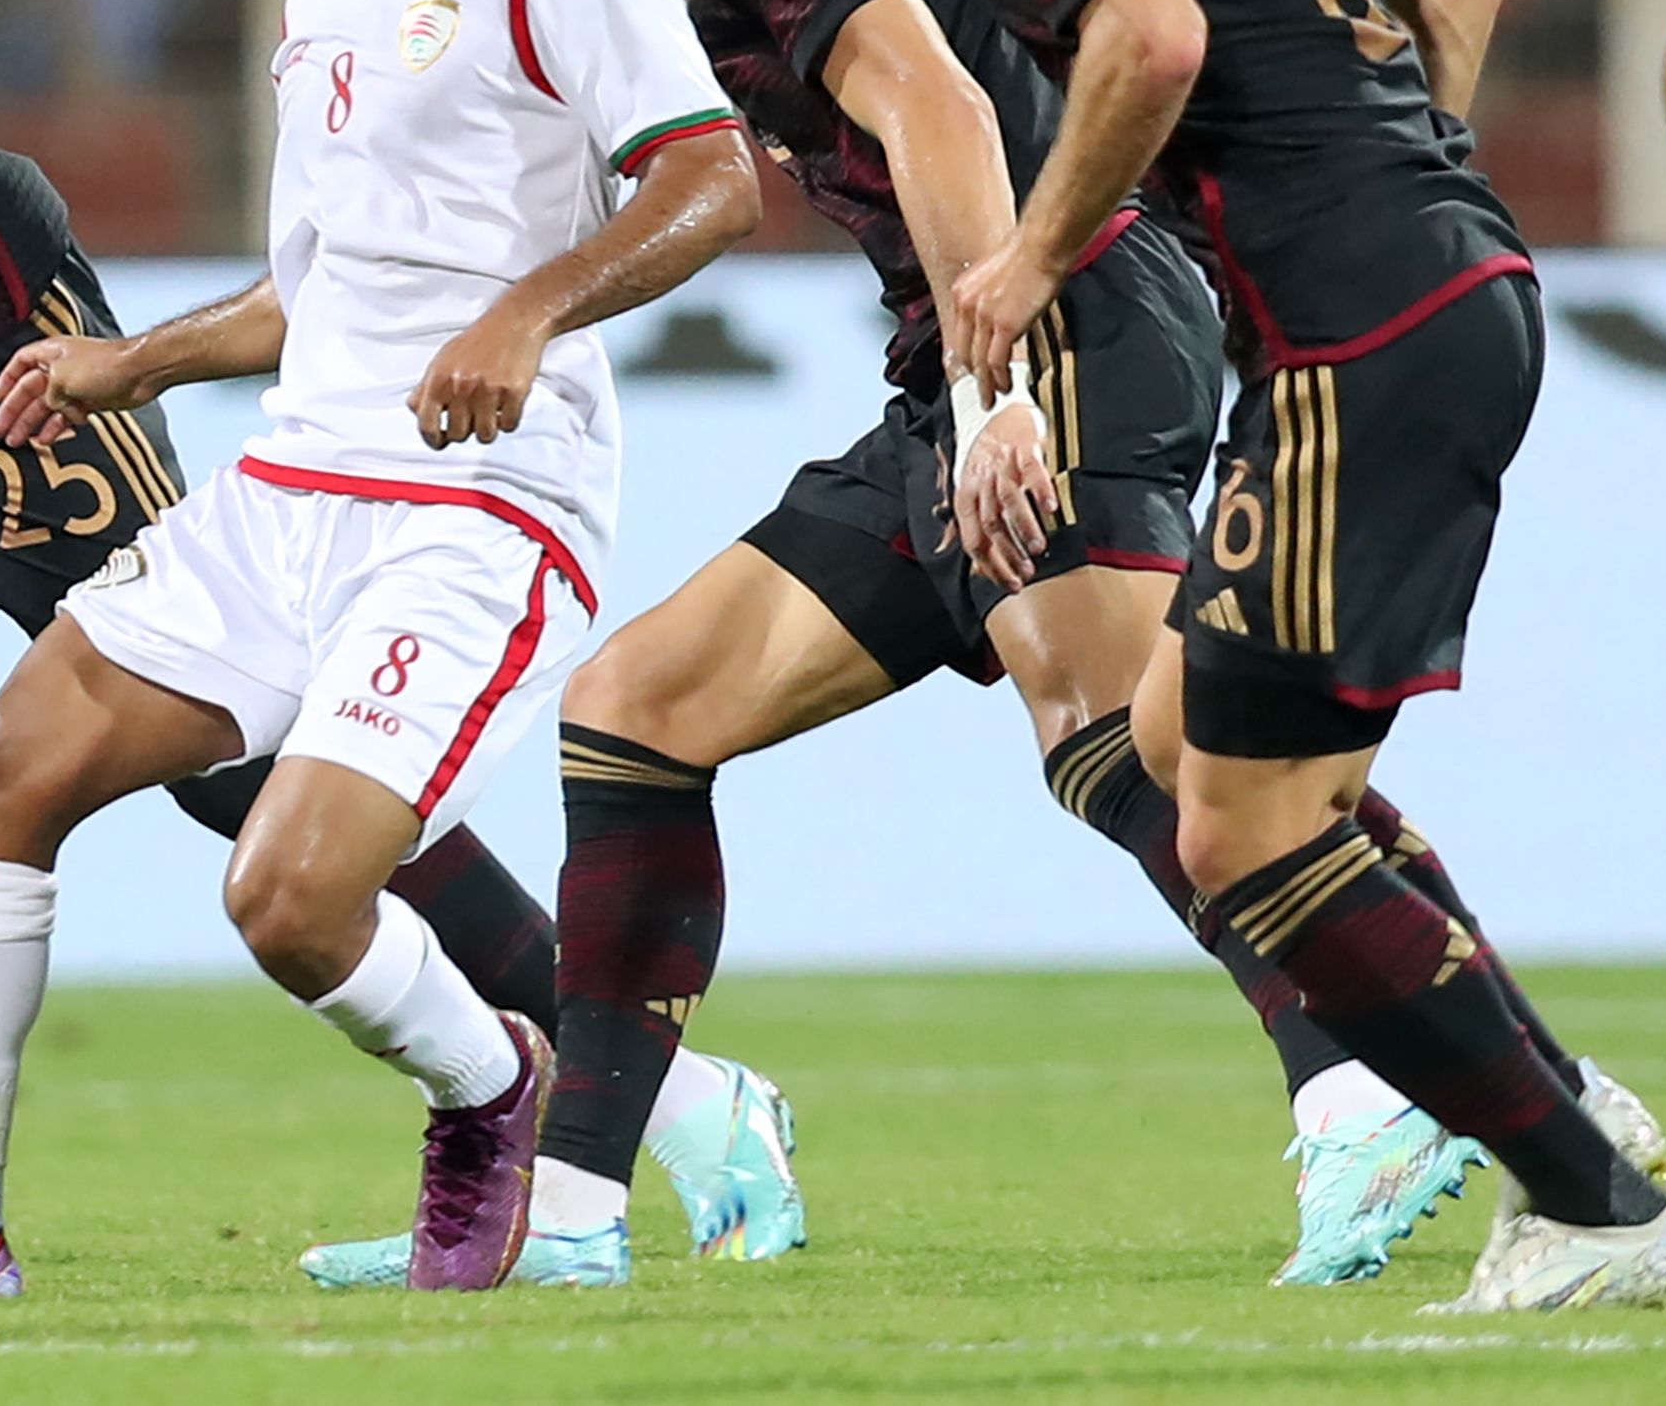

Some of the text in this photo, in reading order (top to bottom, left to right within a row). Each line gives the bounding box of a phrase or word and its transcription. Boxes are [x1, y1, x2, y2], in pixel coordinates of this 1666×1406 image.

[327, 50, 354, 134] 8
[1213, 458, 1265, 572] 6
[370, 633, 421, 697] 8
[334, 698, 402, 737] JAKO
